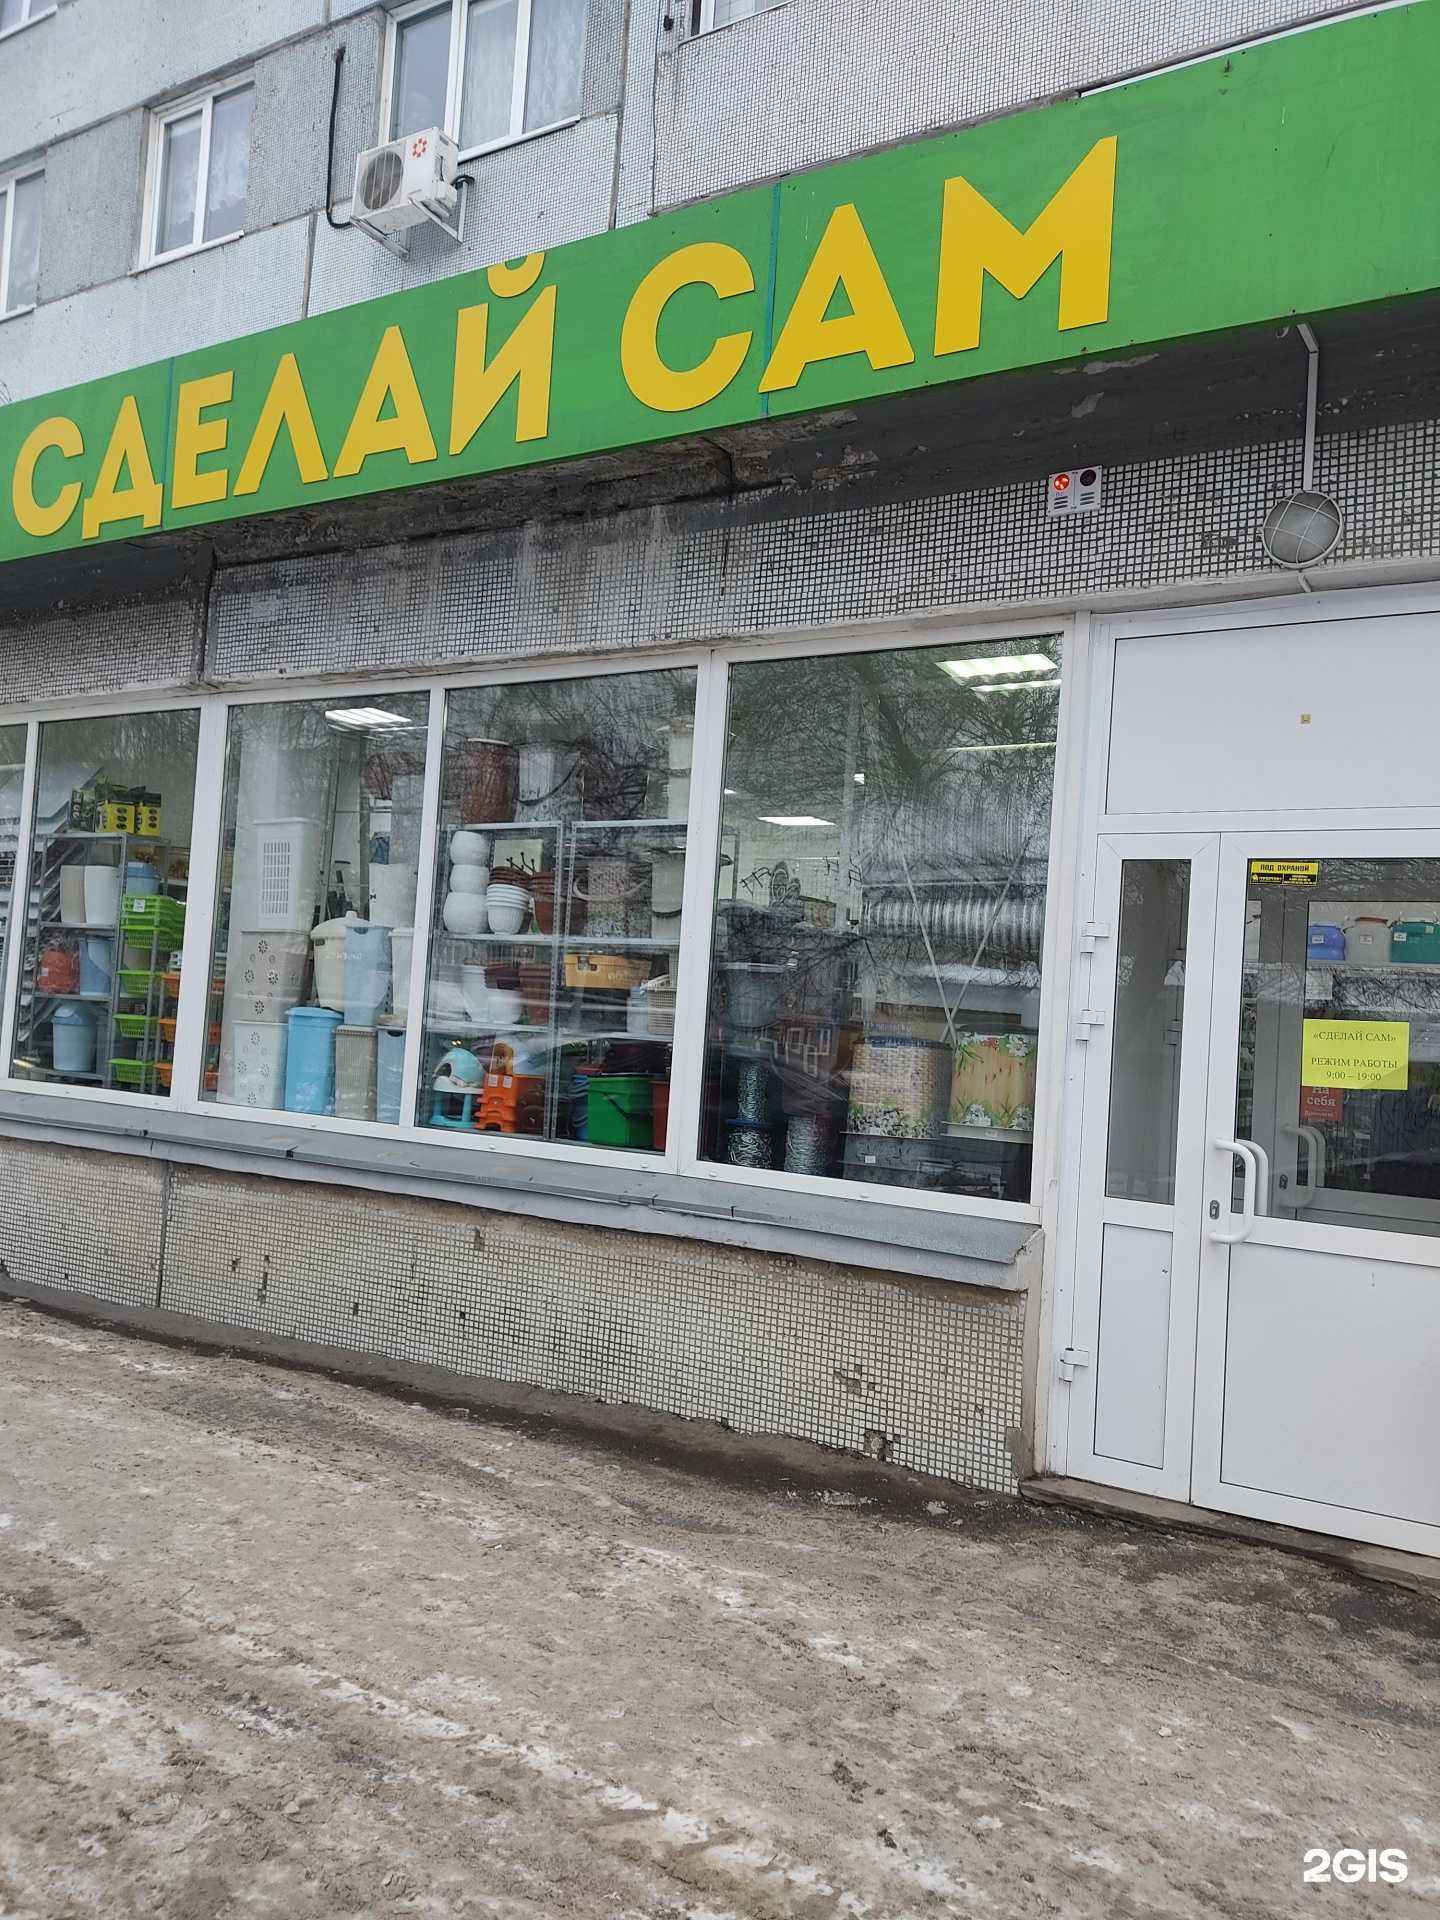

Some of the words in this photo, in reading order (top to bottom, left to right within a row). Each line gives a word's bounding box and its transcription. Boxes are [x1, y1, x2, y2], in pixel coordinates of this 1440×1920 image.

[11, 252, 556, 540] СДЕЛАЙ
[621, 136, 1118, 411] САМ
[1260, 864, 1275, 872] ПОД
[1277, 864, 1310, 872] ОХРАНОЙ
[1313, 1030, 1363, 1041] «СДЕЛАЙ
[1365, 1032, 1397, 1043] САМ»
[1311, 1057, 1350, 1067] РЕЖИМ
[1353, 1060, 1398, 1069] РАБОТЫ
[1326, 1071, 1346, 1081] 9:00
[1357, 1072, 1382, 1081] 19:00
[1307, 1096, 1336, 1106] себя
